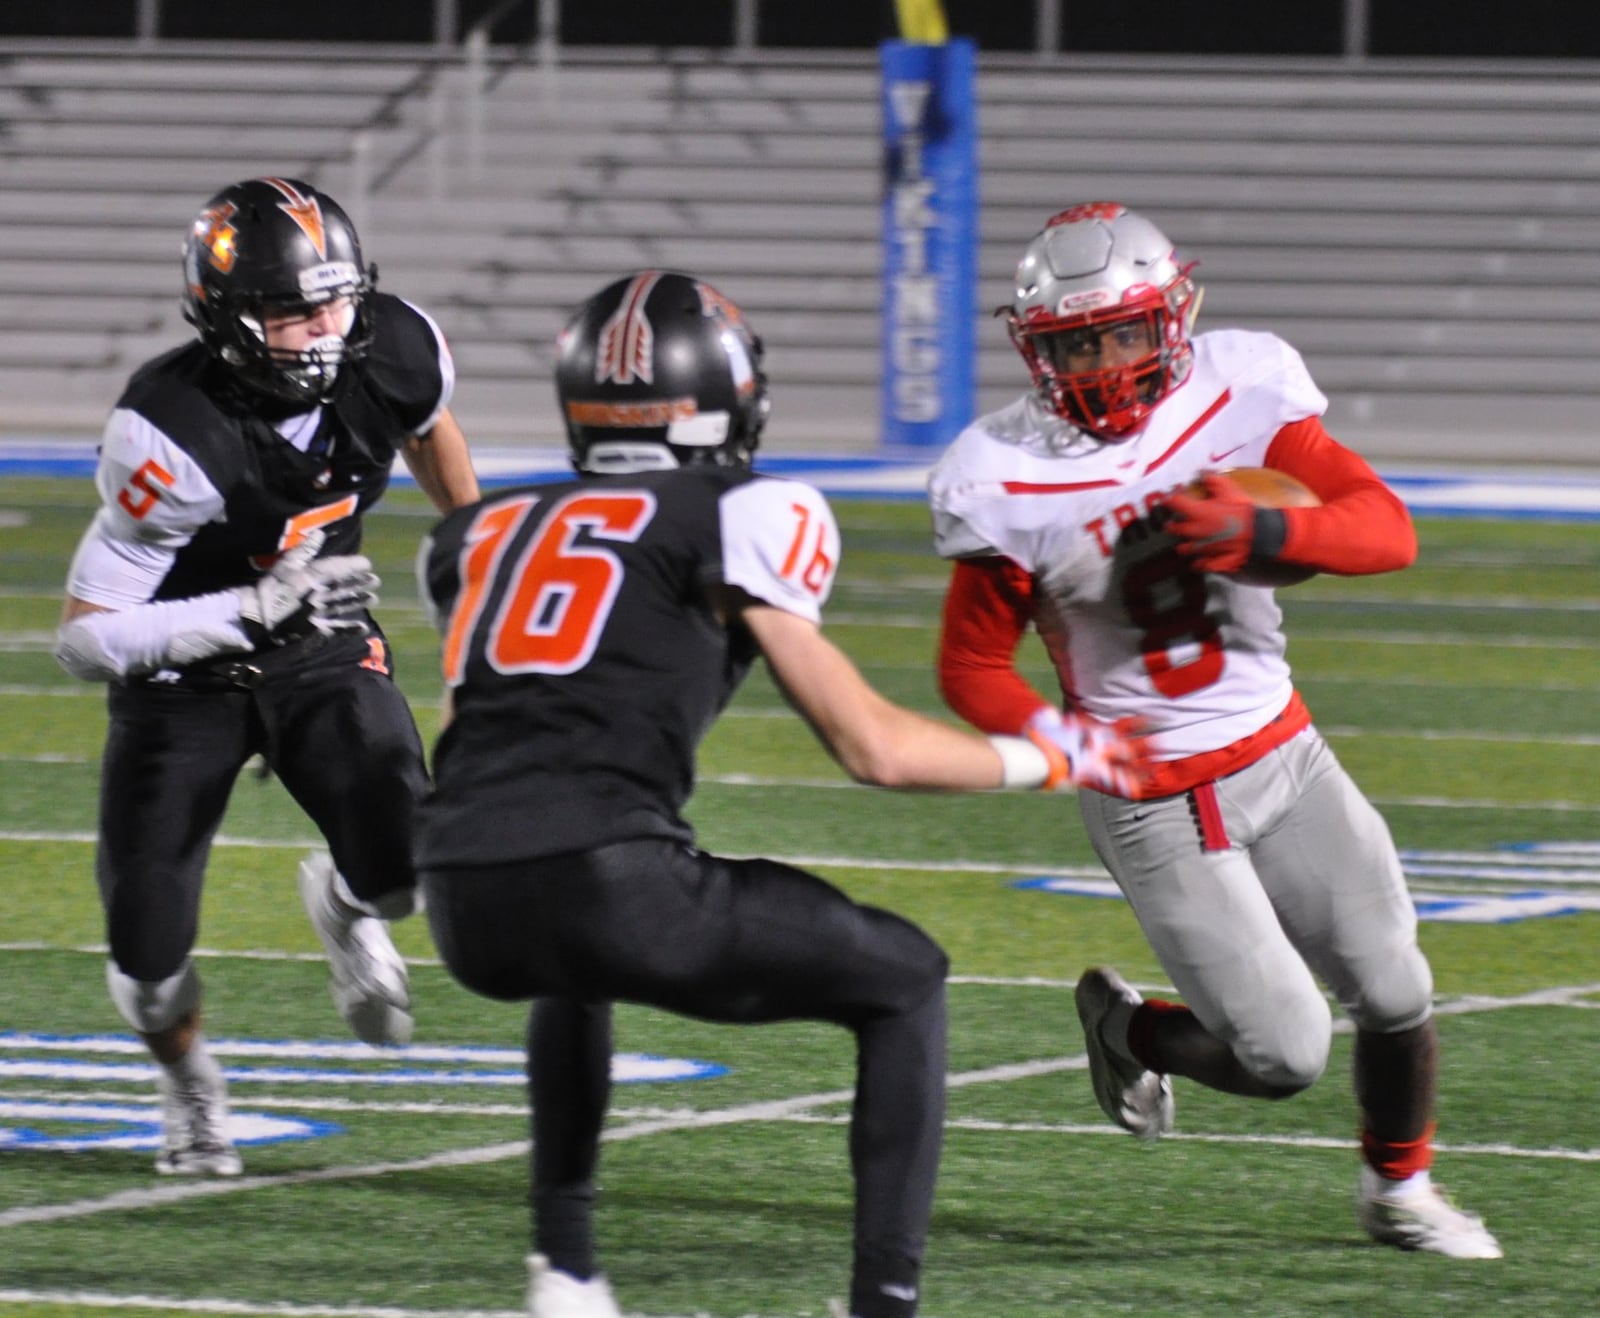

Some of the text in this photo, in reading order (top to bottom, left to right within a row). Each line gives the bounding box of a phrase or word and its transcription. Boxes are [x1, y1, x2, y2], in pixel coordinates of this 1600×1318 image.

[116, 459, 176, 521] 5
[779, 501, 833, 596] 16
[441, 488, 658, 688] 16
[1121, 552, 1227, 700] 8
